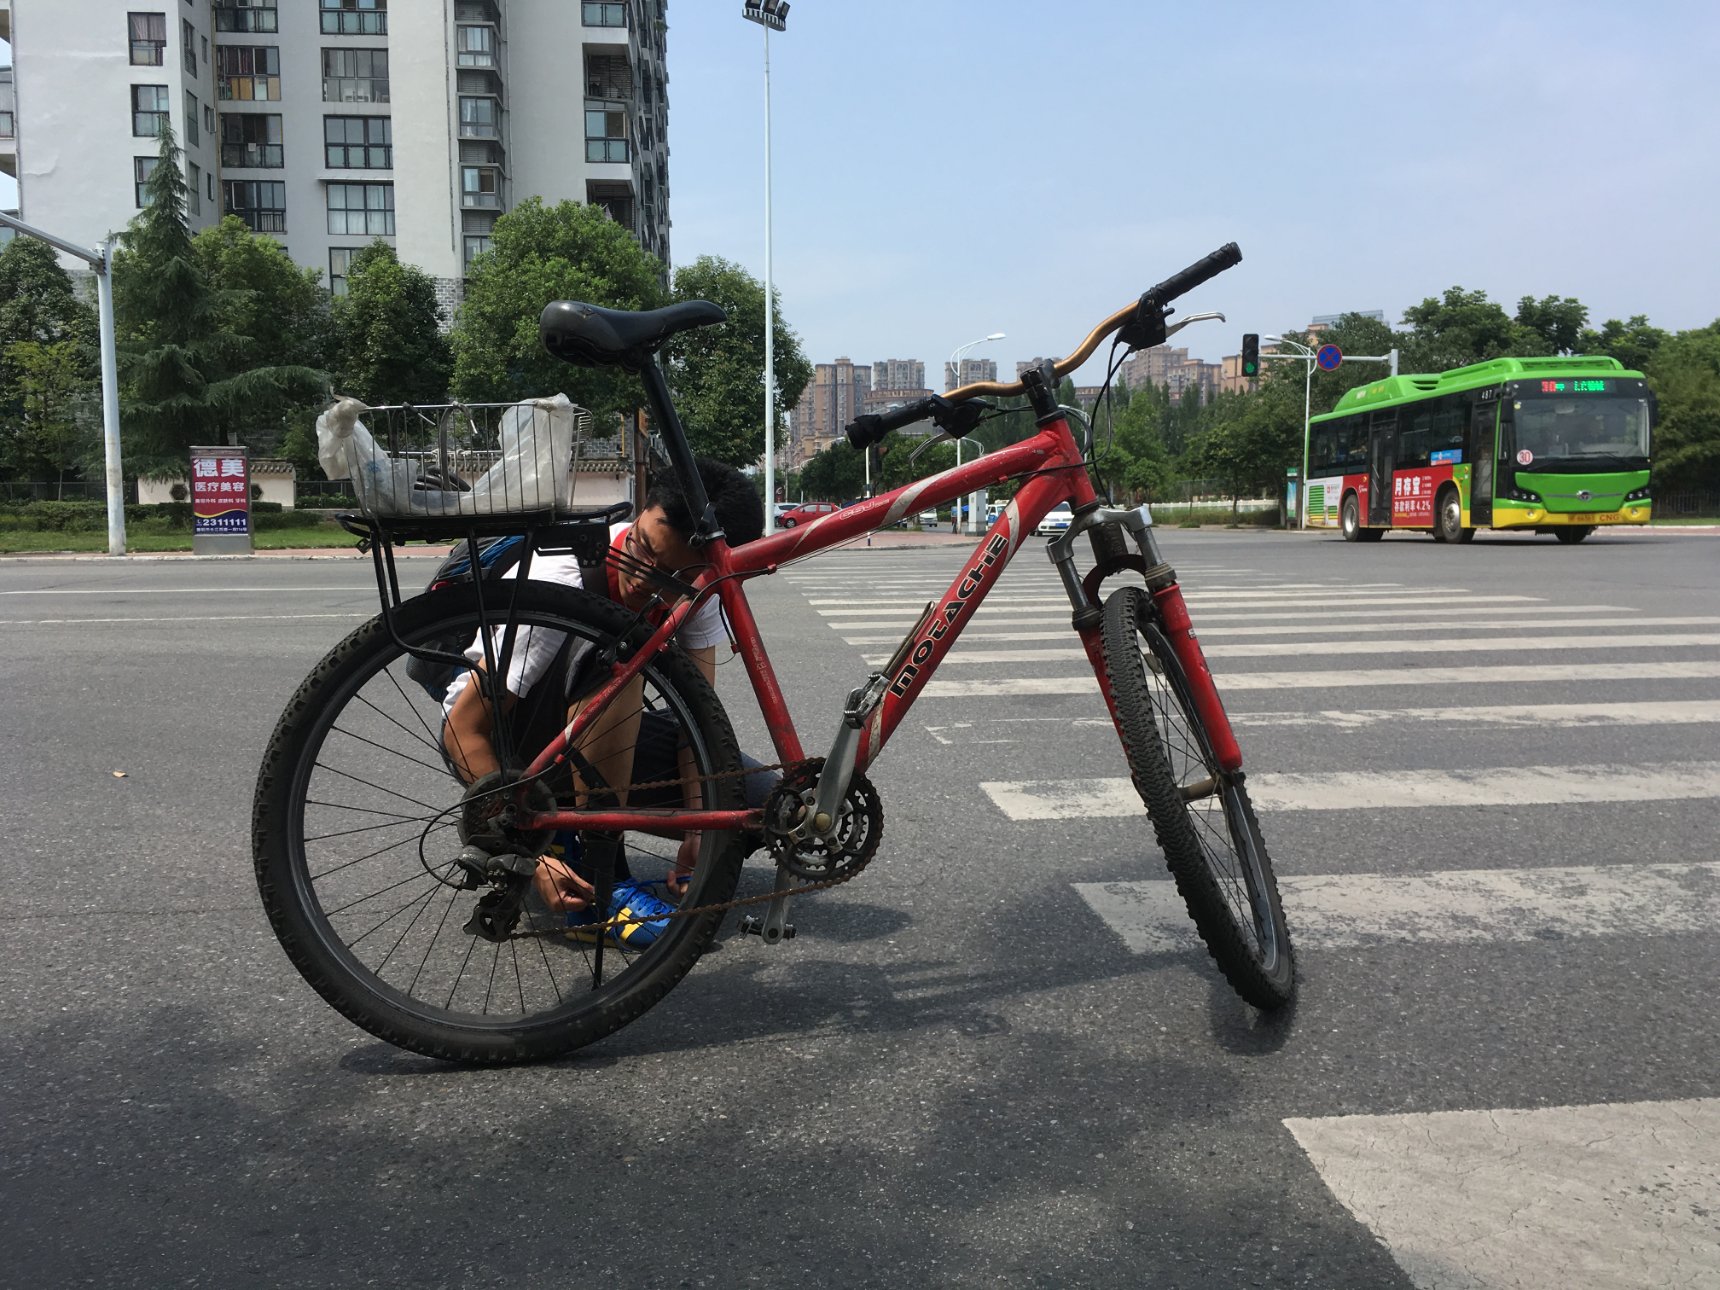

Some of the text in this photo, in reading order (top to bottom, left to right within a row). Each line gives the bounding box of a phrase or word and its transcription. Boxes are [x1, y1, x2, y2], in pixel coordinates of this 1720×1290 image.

[1519, 451, 1531, 463] 30
[193, 459, 245, 477] 德美
[194, 481, 245, 492] 医疗美容
[202, 518, 247, 526] 2311111
[1599, 513, 1620, 521] CNG
